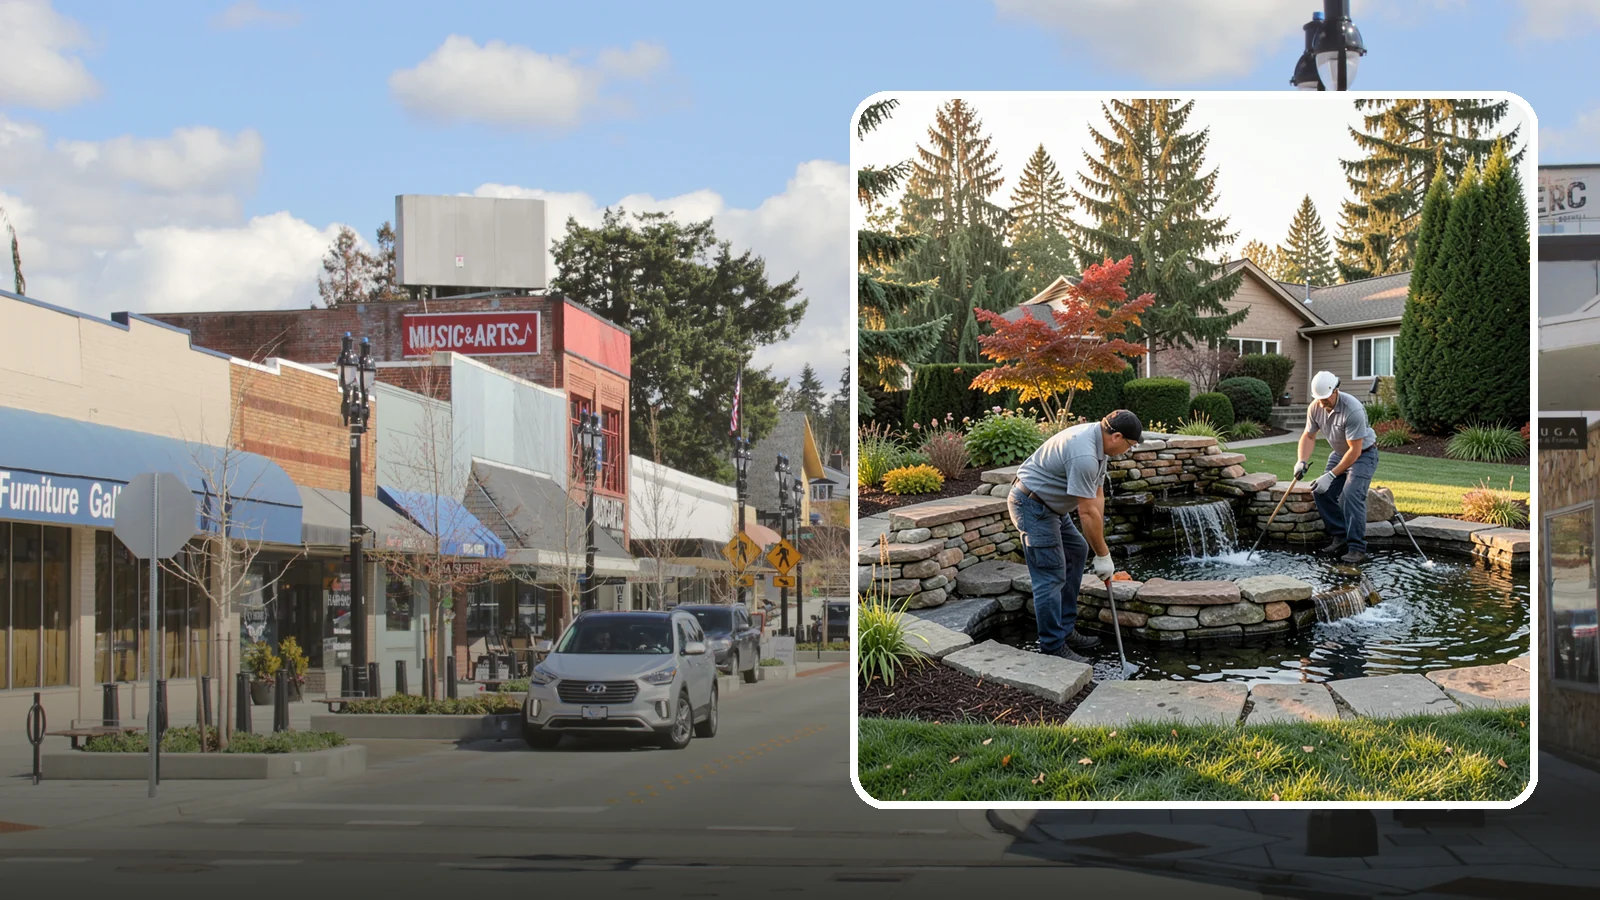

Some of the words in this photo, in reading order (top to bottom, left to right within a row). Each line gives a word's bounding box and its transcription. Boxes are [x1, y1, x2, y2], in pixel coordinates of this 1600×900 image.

[0, 471, 79, 515] Furniture
[89, 482, 122, 519] Gal
[453, 562, 479, 574] SUSHI
